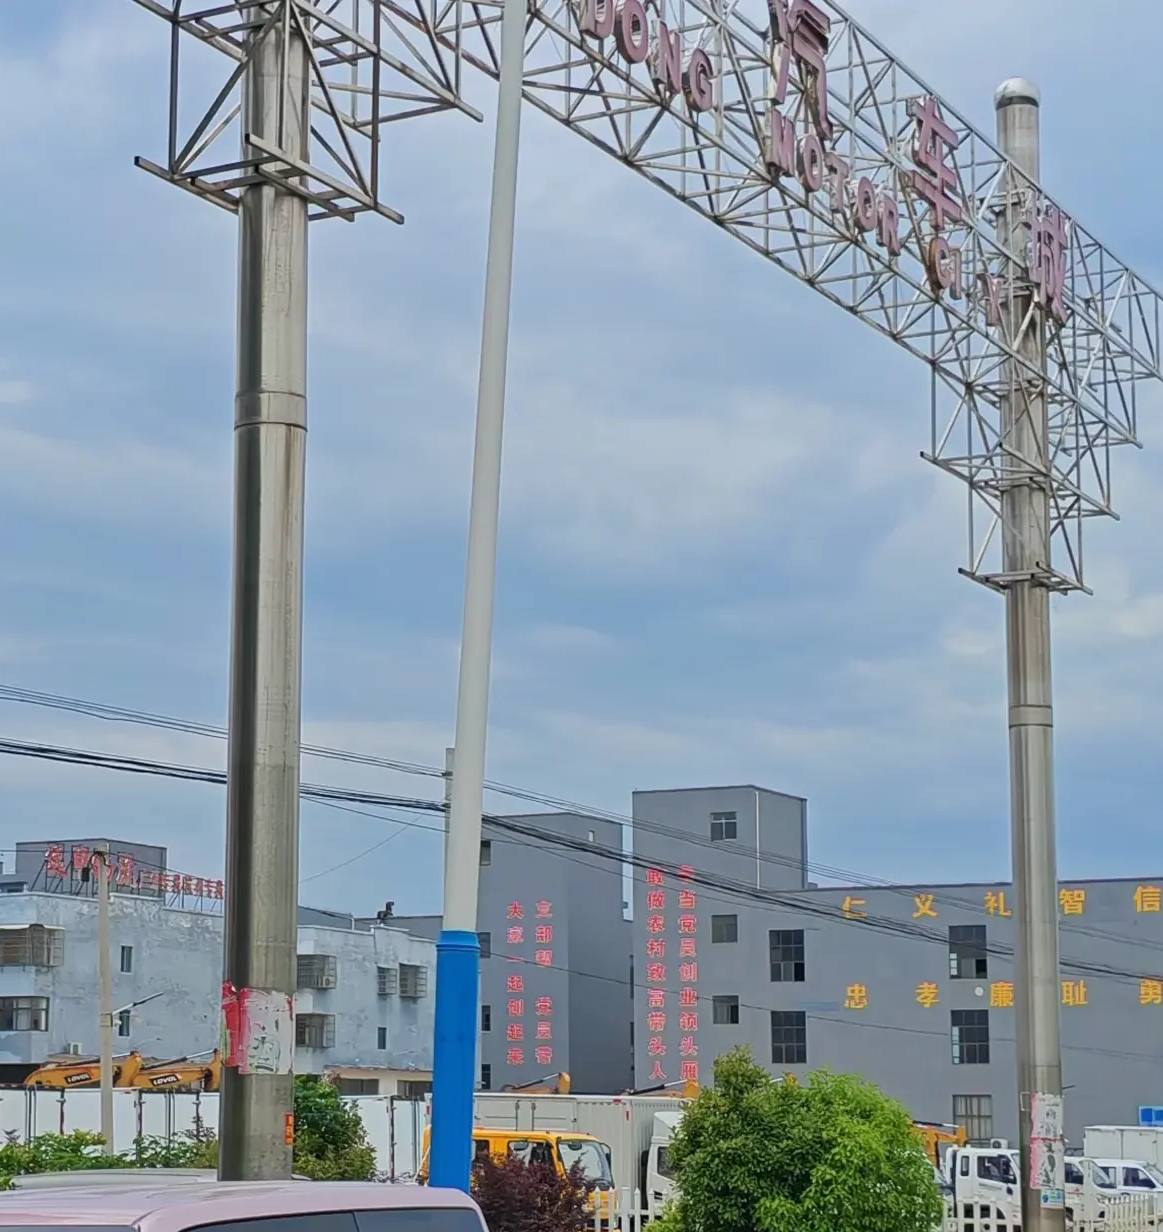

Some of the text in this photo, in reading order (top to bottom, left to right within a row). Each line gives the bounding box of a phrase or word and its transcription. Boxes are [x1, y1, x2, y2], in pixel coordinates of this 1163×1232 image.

[764, 108, 901, 257] MOTOR
[646, 867, 667, 1080] 敢做农村致富带头人
